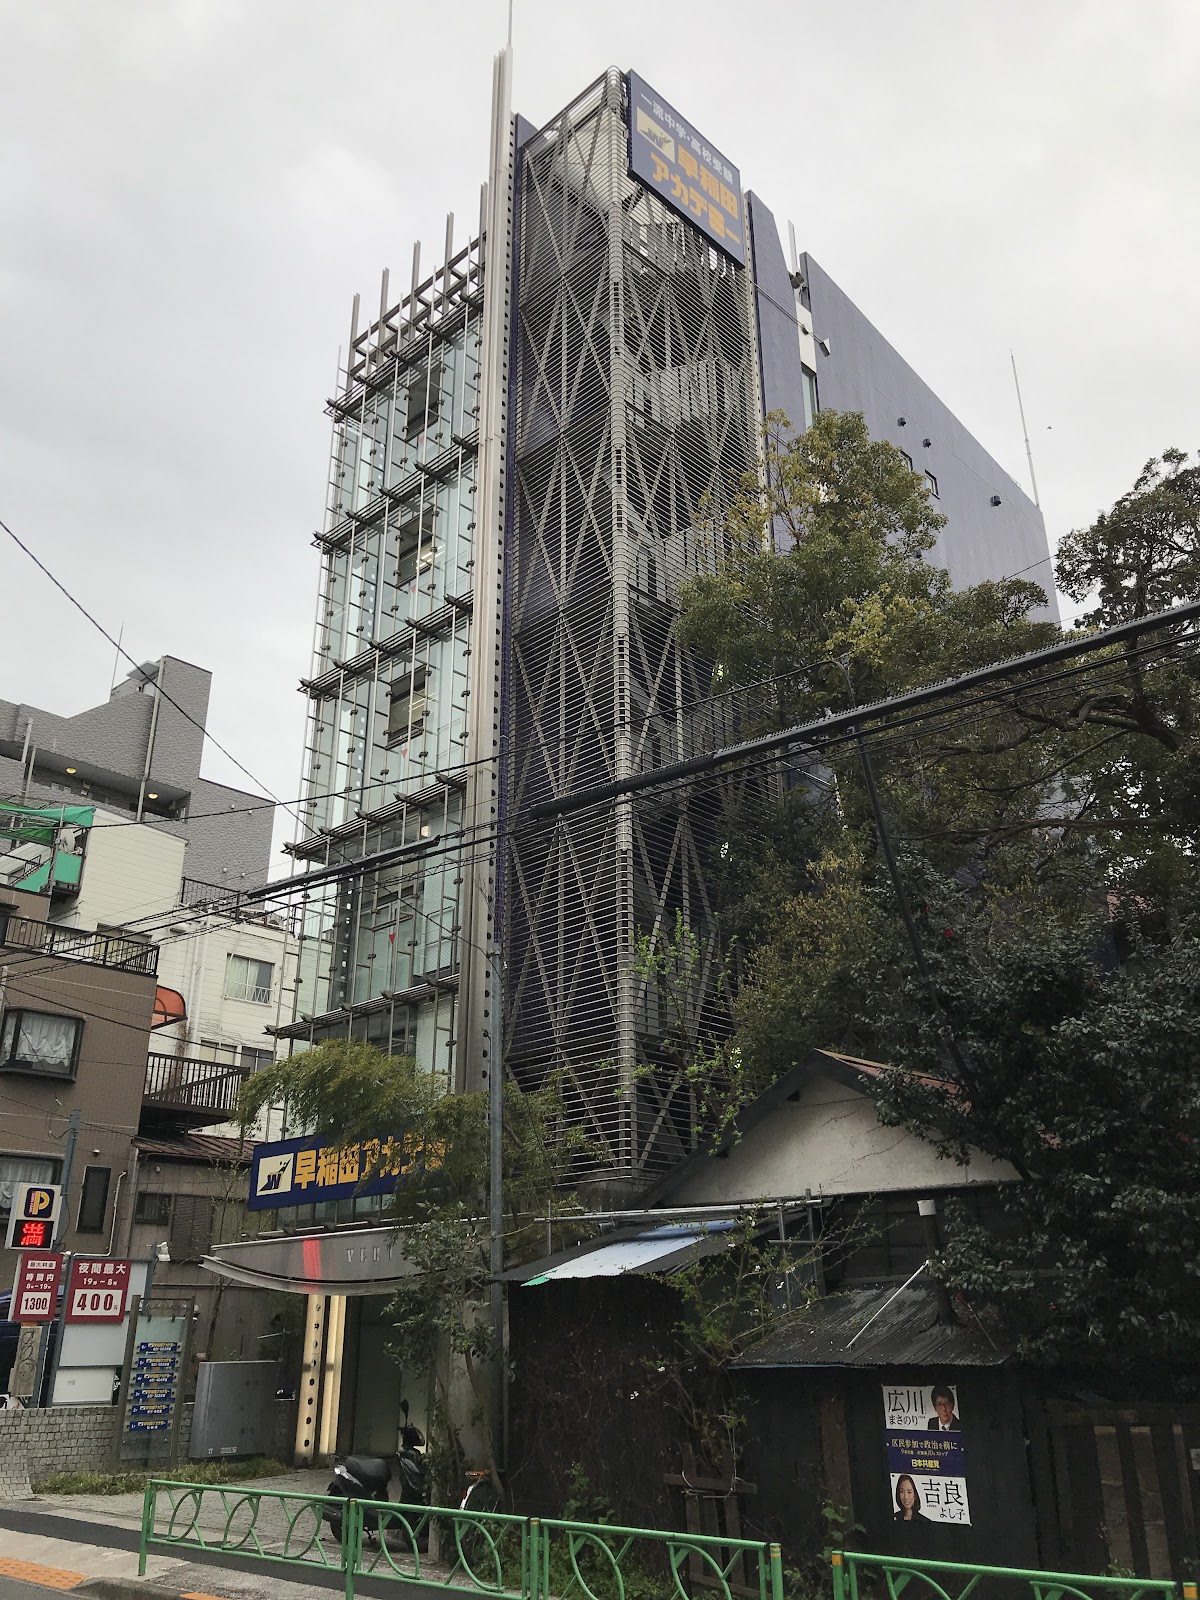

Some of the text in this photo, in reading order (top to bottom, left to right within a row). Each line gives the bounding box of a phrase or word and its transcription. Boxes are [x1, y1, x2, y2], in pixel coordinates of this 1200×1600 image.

[678, 144, 739, 220] 早稲田
[650, 151, 741, 245] アカデミー
[79, 1262, 127, 1275] 夜間最大
[887, 1389, 925, 1415] 広川
[889, 1414, 918, 1426] まさのり
[921, 1479, 964, 1506] 吉良
[940, 1507, 965, 1521] よし子
